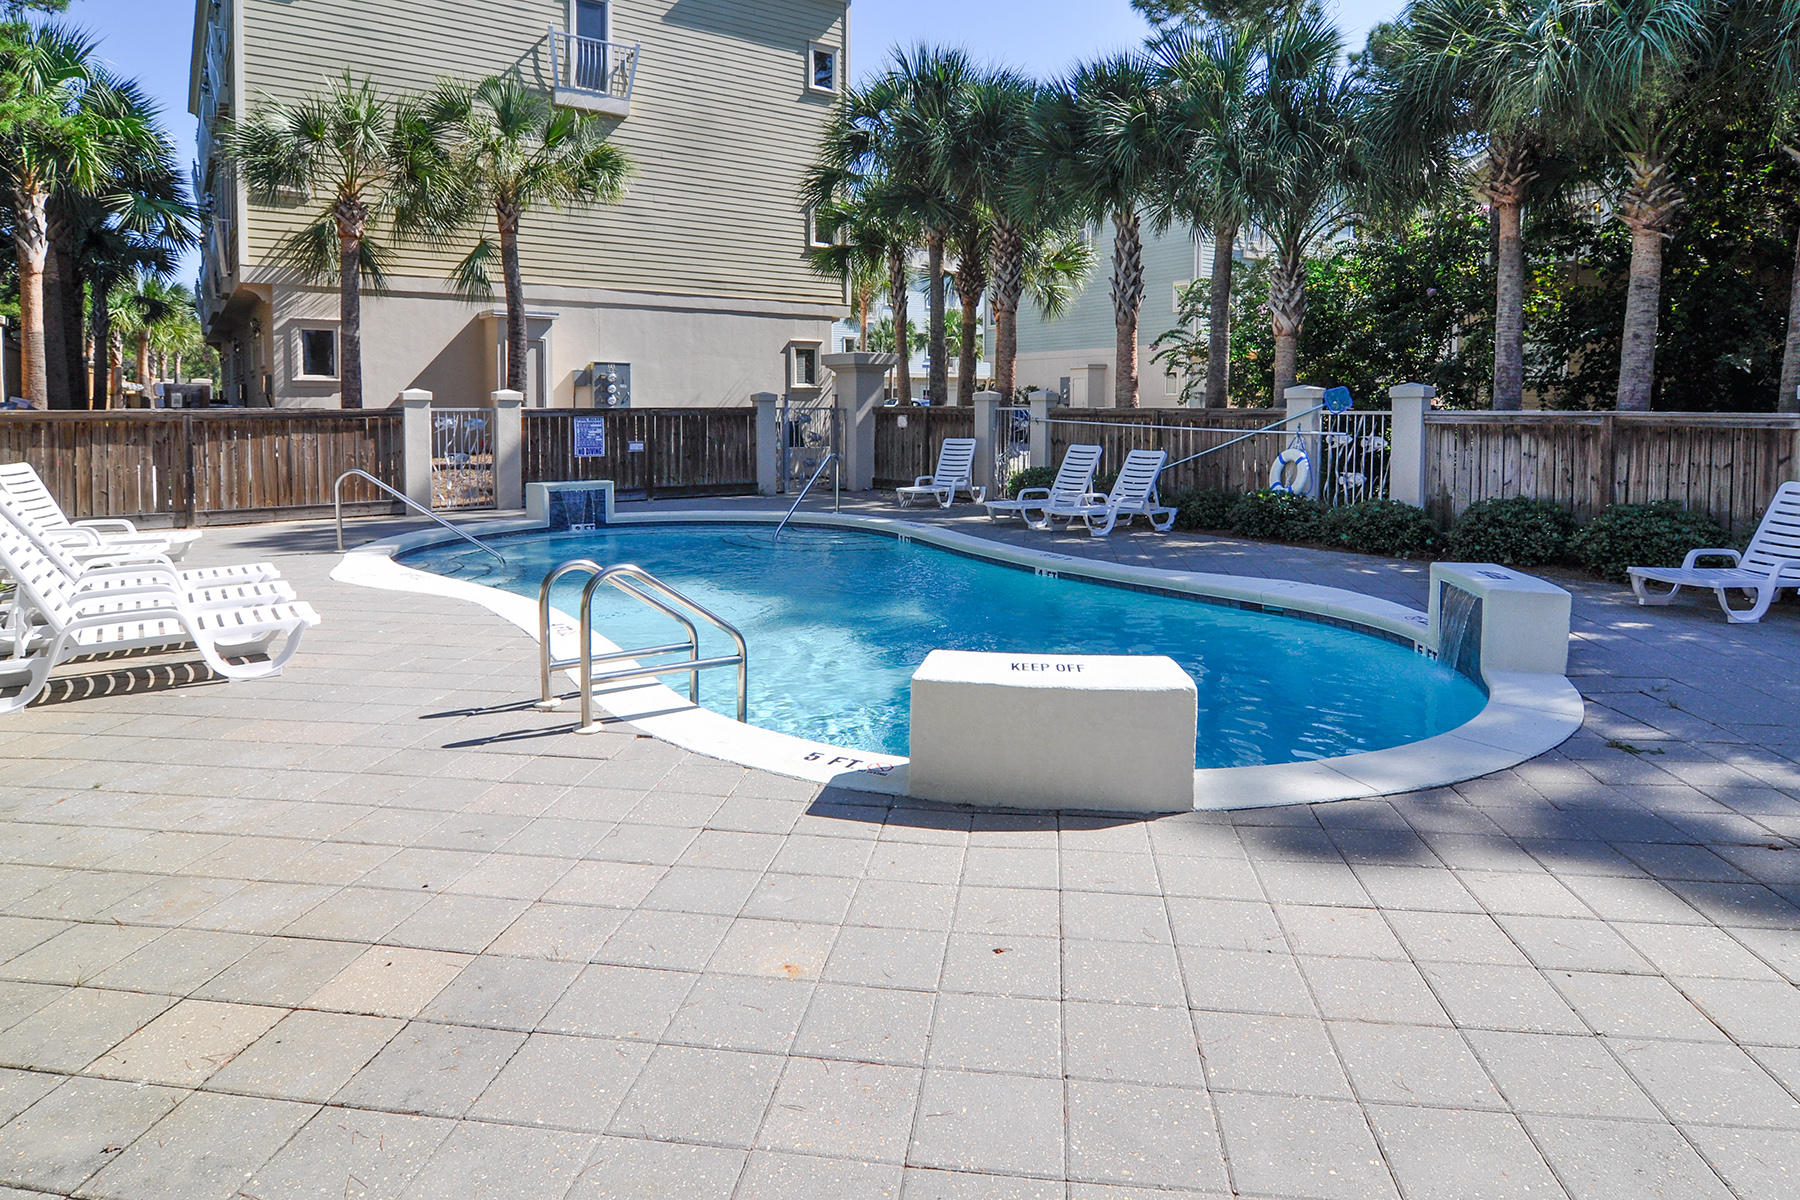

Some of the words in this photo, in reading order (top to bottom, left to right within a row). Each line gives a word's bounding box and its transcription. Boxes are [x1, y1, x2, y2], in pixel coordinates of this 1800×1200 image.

[1011, 662, 1050, 672] KEEP
[1055, 663, 1085, 673] OFF
[803, 752, 825, 761] 5
